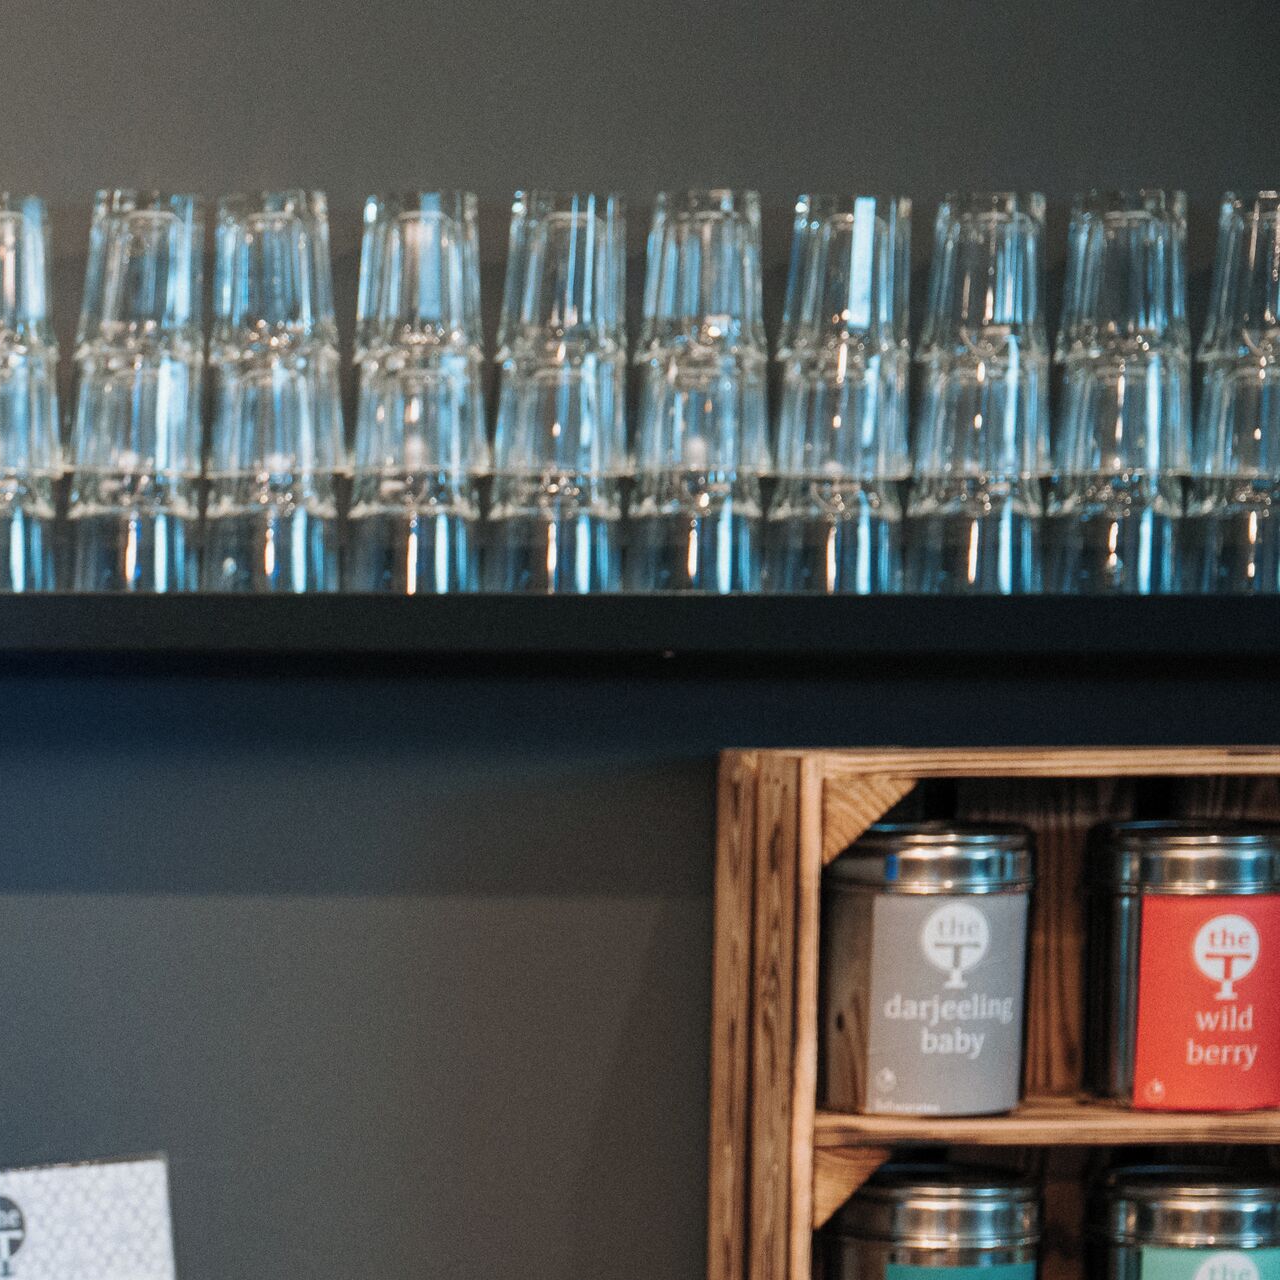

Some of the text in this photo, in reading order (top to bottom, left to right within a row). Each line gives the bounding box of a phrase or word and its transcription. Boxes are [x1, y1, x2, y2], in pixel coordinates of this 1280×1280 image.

[1209, 927, 1251, 948] the
[1205, 953, 1251, 980] T
[883, 993, 1014, 1026] darjeeling
[1196, 1004, 1254, 1031] wild
[920, 1027, 986, 1059] baby
[1186, 1038, 1258, 1071] berry
